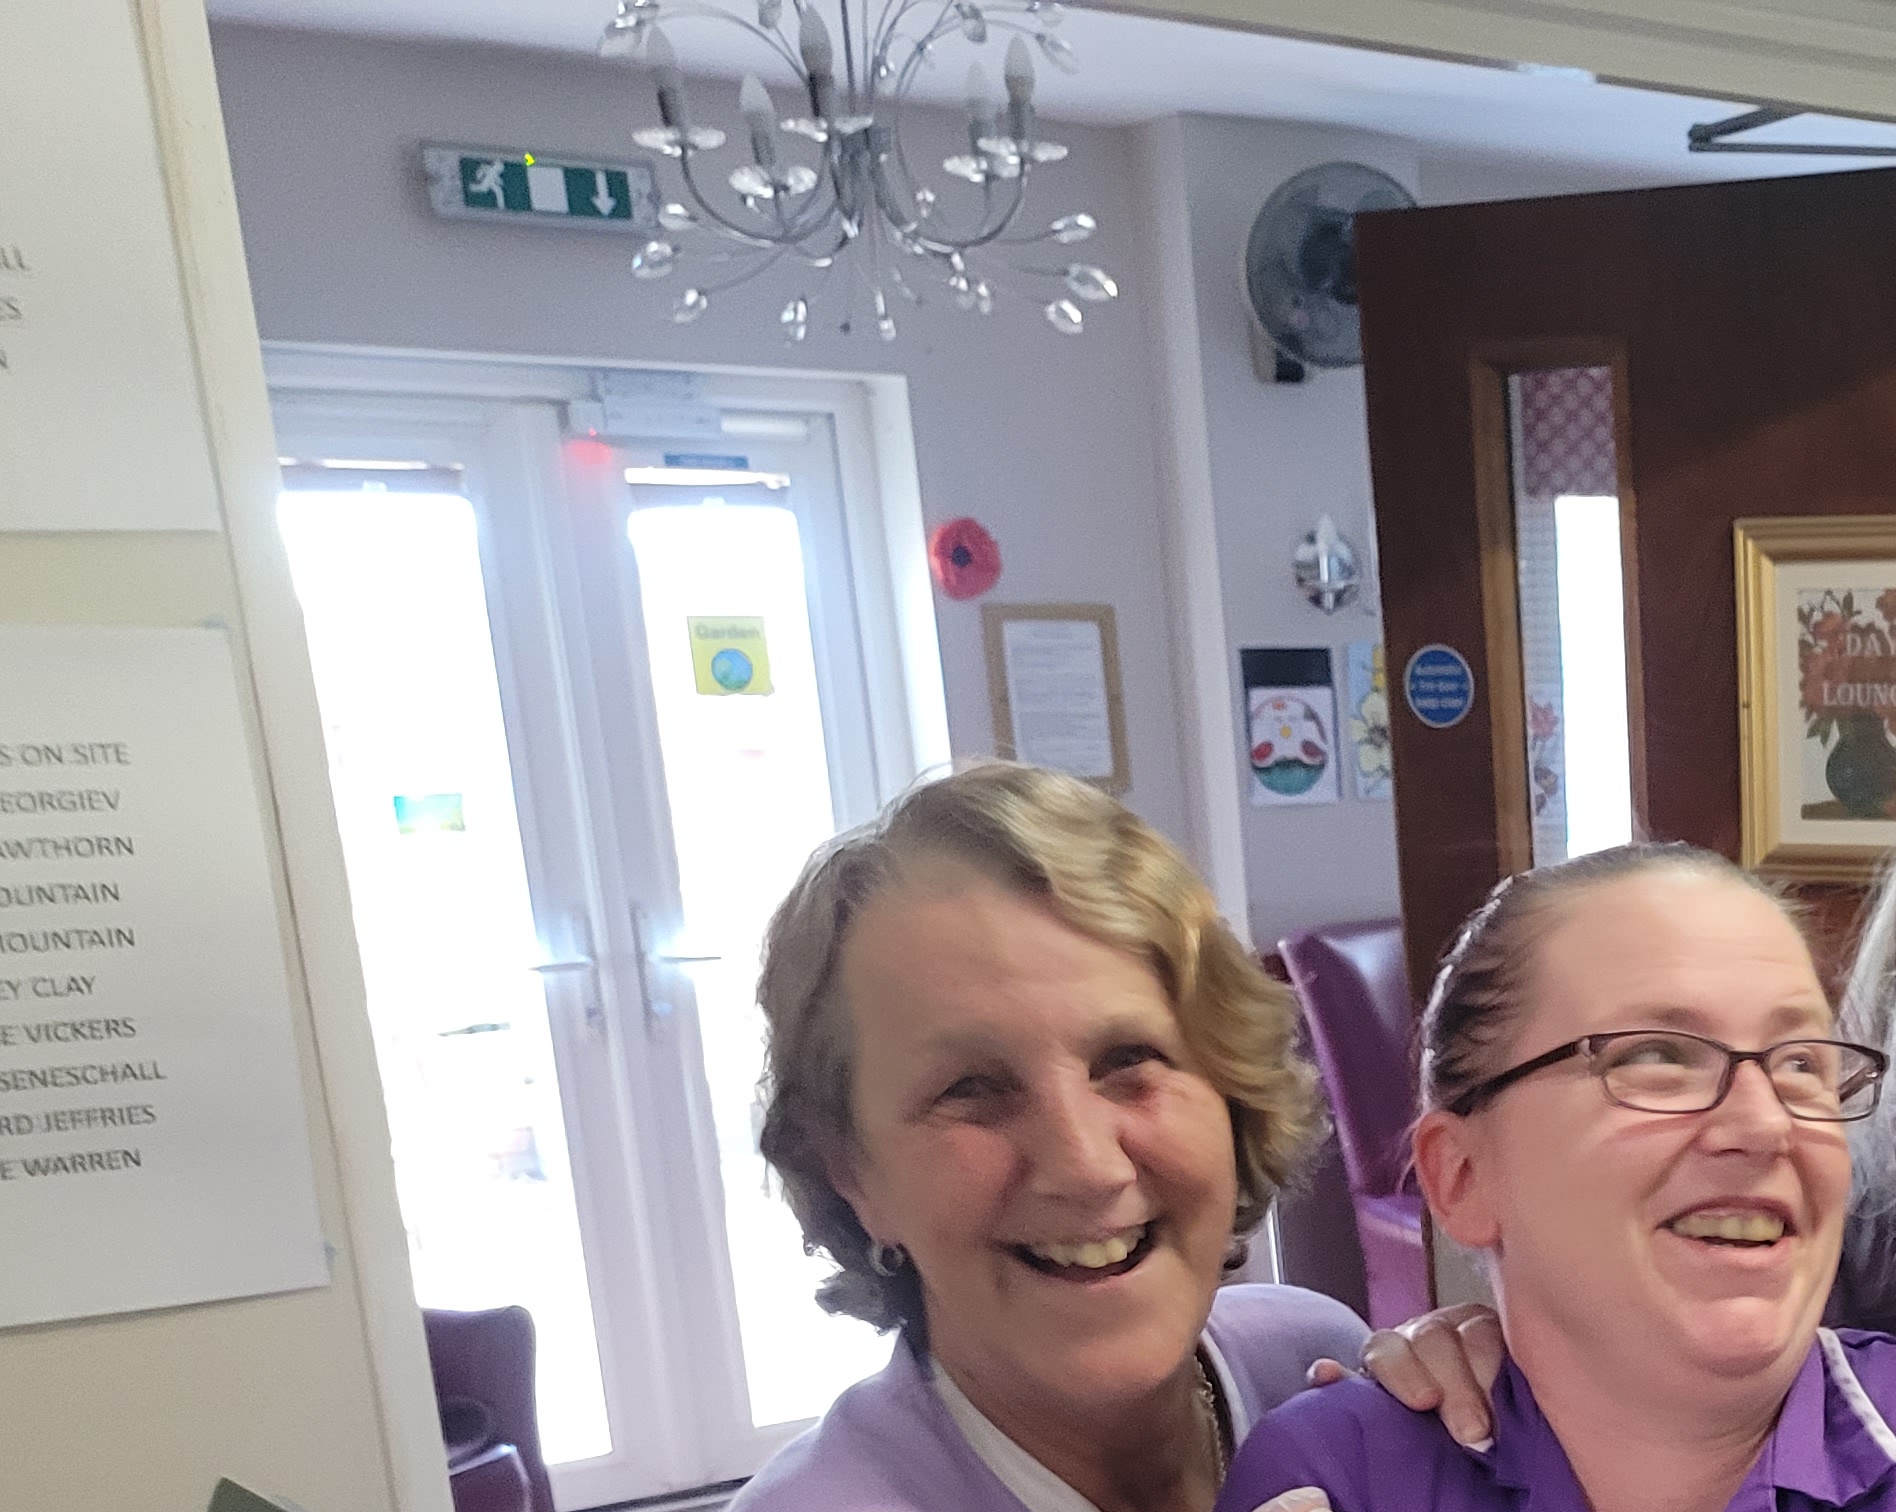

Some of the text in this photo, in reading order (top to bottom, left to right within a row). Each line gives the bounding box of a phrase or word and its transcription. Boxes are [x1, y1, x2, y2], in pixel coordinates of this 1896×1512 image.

[20, 744, 63, 767] ON
[70, 741, 131, 766] SITE
[29, 975, 96, 998] CLAY
[23, 1016, 137, 1043] VICKERS
[42, 1104, 157, 1134] JEFFRIES
[22, 1149, 141, 1178] WARREN
